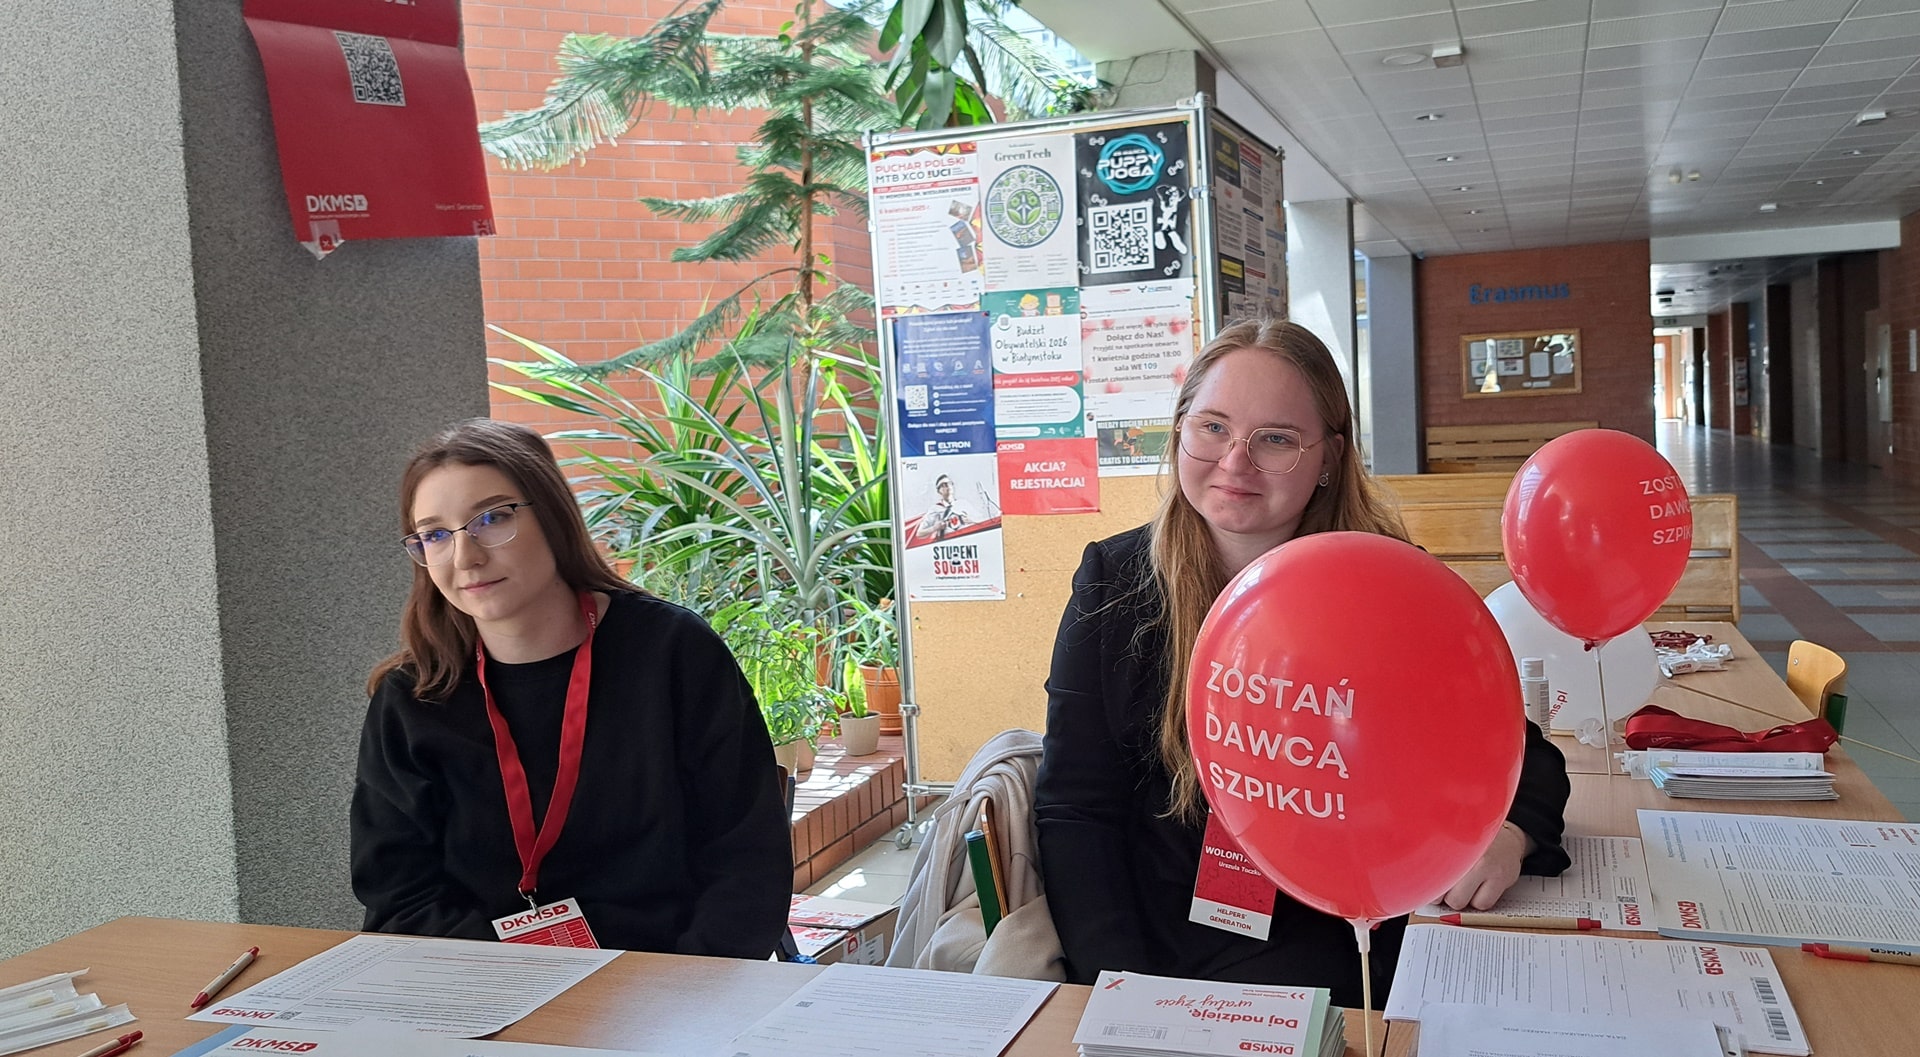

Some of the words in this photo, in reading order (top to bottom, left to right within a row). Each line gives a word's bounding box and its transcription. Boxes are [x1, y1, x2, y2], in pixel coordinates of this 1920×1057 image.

[994, 148, 1051, 162] GreenTech
[1098, 152, 1161, 170] PUPPY
[876, 162, 921, 173] PUCHAR
[925, 157, 965, 168] POLSKI
[1106, 164, 1154, 180] JOGA
[876, 174, 899, 184] MTB
[903, 172, 925, 180] XCO
[306, 195, 355, 212] DKMS
[1469, 284, 1570, 304] Erasmus
[1017, 325, 1044, 336] Budżet
[1106, 333, 1132, 342] Dołącz
[1134, 332, 1144, 340] do
[995, 339, 1046, 352] Obywatelski
[1049, 337, 1068, 348] 2026
[1124, 342, 1153, 351] spotkanie
[1012, 352, 1062, 365] Białymstoku
[1098, 353, 1129, 362] kwietnia
[1131, 352, 1160, 361] godzina
[1162, 350, 1181, 358] 18:00
[1114, 364, 1129, 372] sala
[938, 441, 970, 449] ELTRON
[1024, 462, 1066, 473] AKCJA?
[1010, 477, 1085, 489] REJESTRACJA!
[1639, 476, 1683, 496] ZOST
[933, 545, 978, 560] STUDENT
[934, 560, 980, 575] SQUASH
[1206, 661, 1354, 718] ZOSTAŃ
[1206, 712, 1349, 779] DAWCĄ
[1209, 762, 1345, 820] SZPIKU!
[1218, 861, 1240, 871] Urszula
[1624, 904, 1640, 920] DKMS
[1678, 908, 1701, 928] DKMS
[500, 909, 554, 931] DKMS
[1210, 916, 1251, 930] GENERATION
[1699, 947, 1721, 967] DKMS
[1154, 994, 1196, 1009] życie
[1200, 994, 1252, 1012] uratuj
[225, 1008, 275, 1019] DKMS
[1189, 1009, 1264, 1023] nadzieję,
[1268, 1016, 1298, 1029] Daj
[232, 1038, 296, 1051] DKMS
[1252, 1043, 1294, 1055] DKMS
